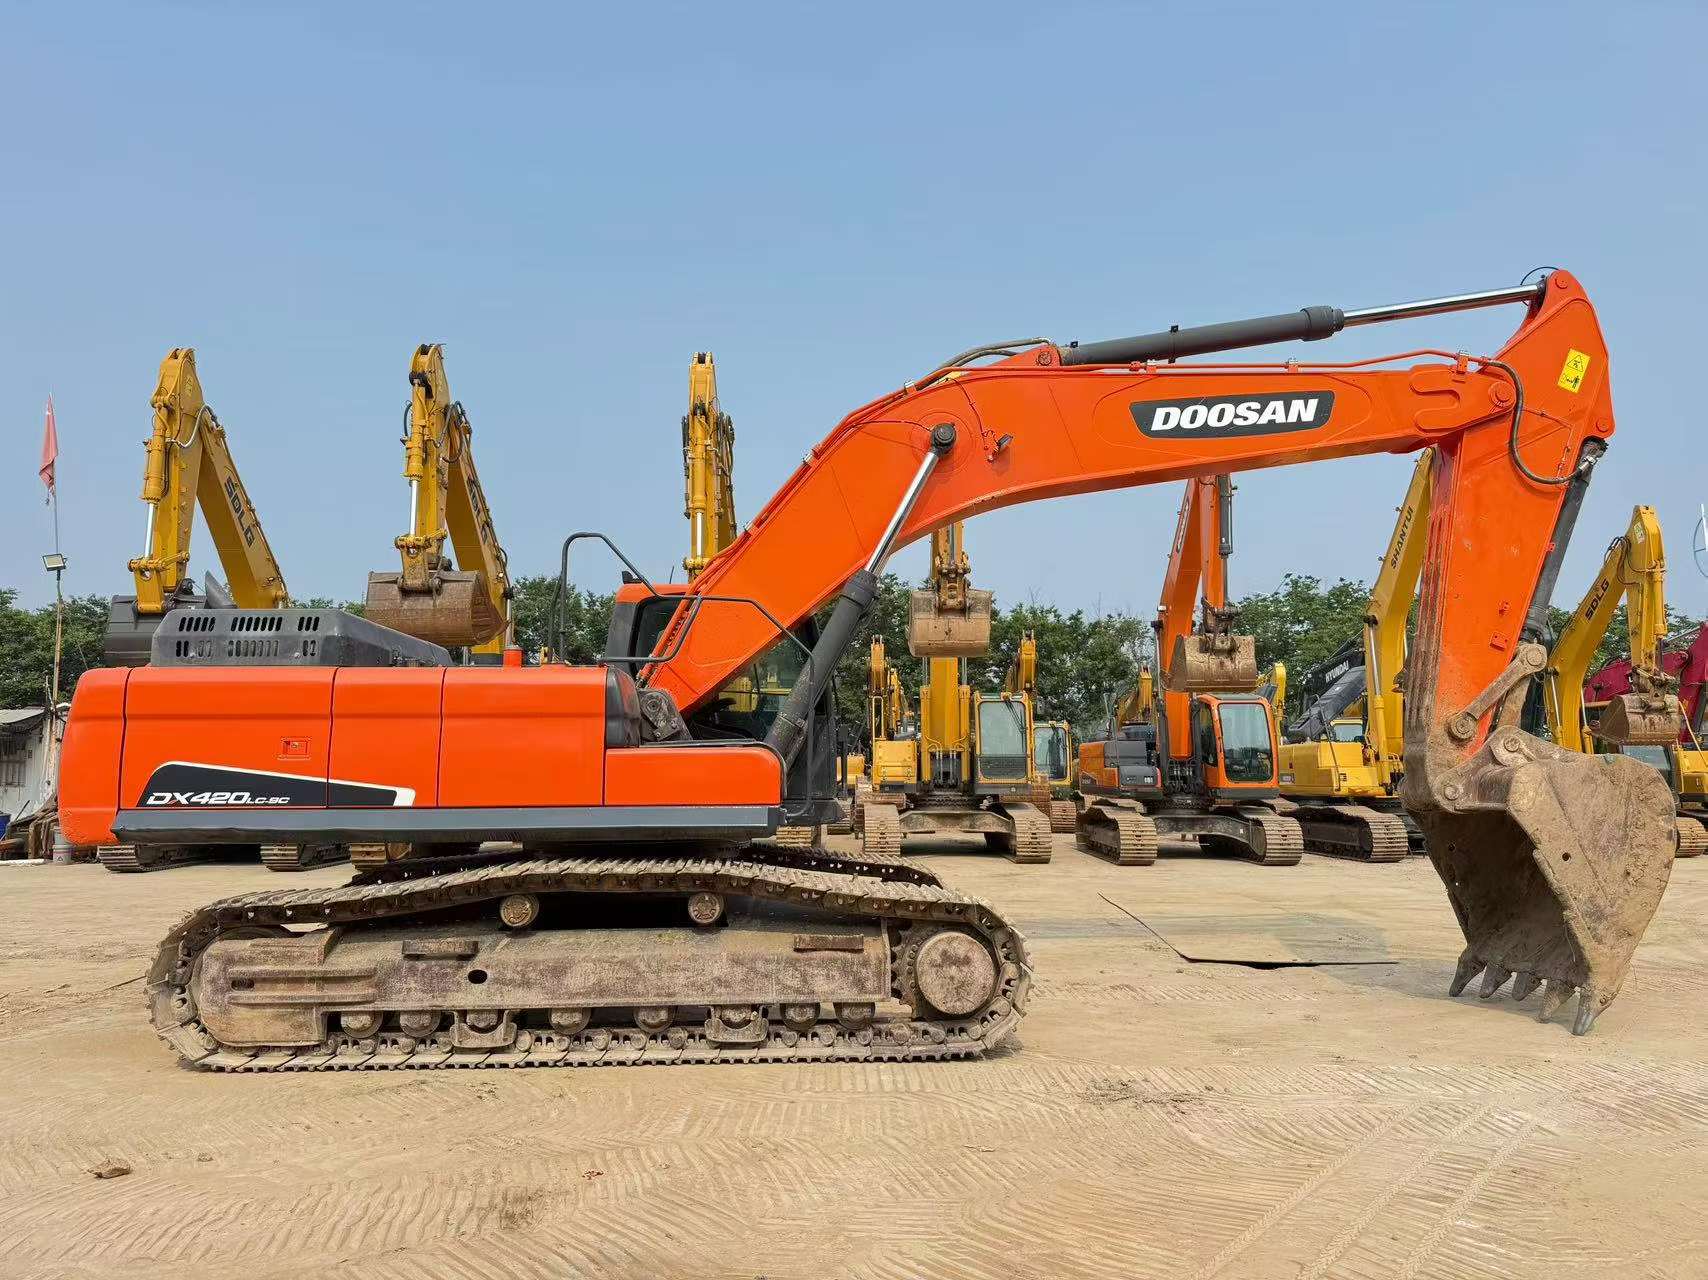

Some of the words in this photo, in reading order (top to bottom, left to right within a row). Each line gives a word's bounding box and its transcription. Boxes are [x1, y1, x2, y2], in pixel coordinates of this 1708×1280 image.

[1151, 399, 1319, 431] DOOSAN
[225, 476, 255, 548] SDLG
[1391, 506, 1413, 569] SHANTUI
[1585, 578, 1610, 620] SDLG
